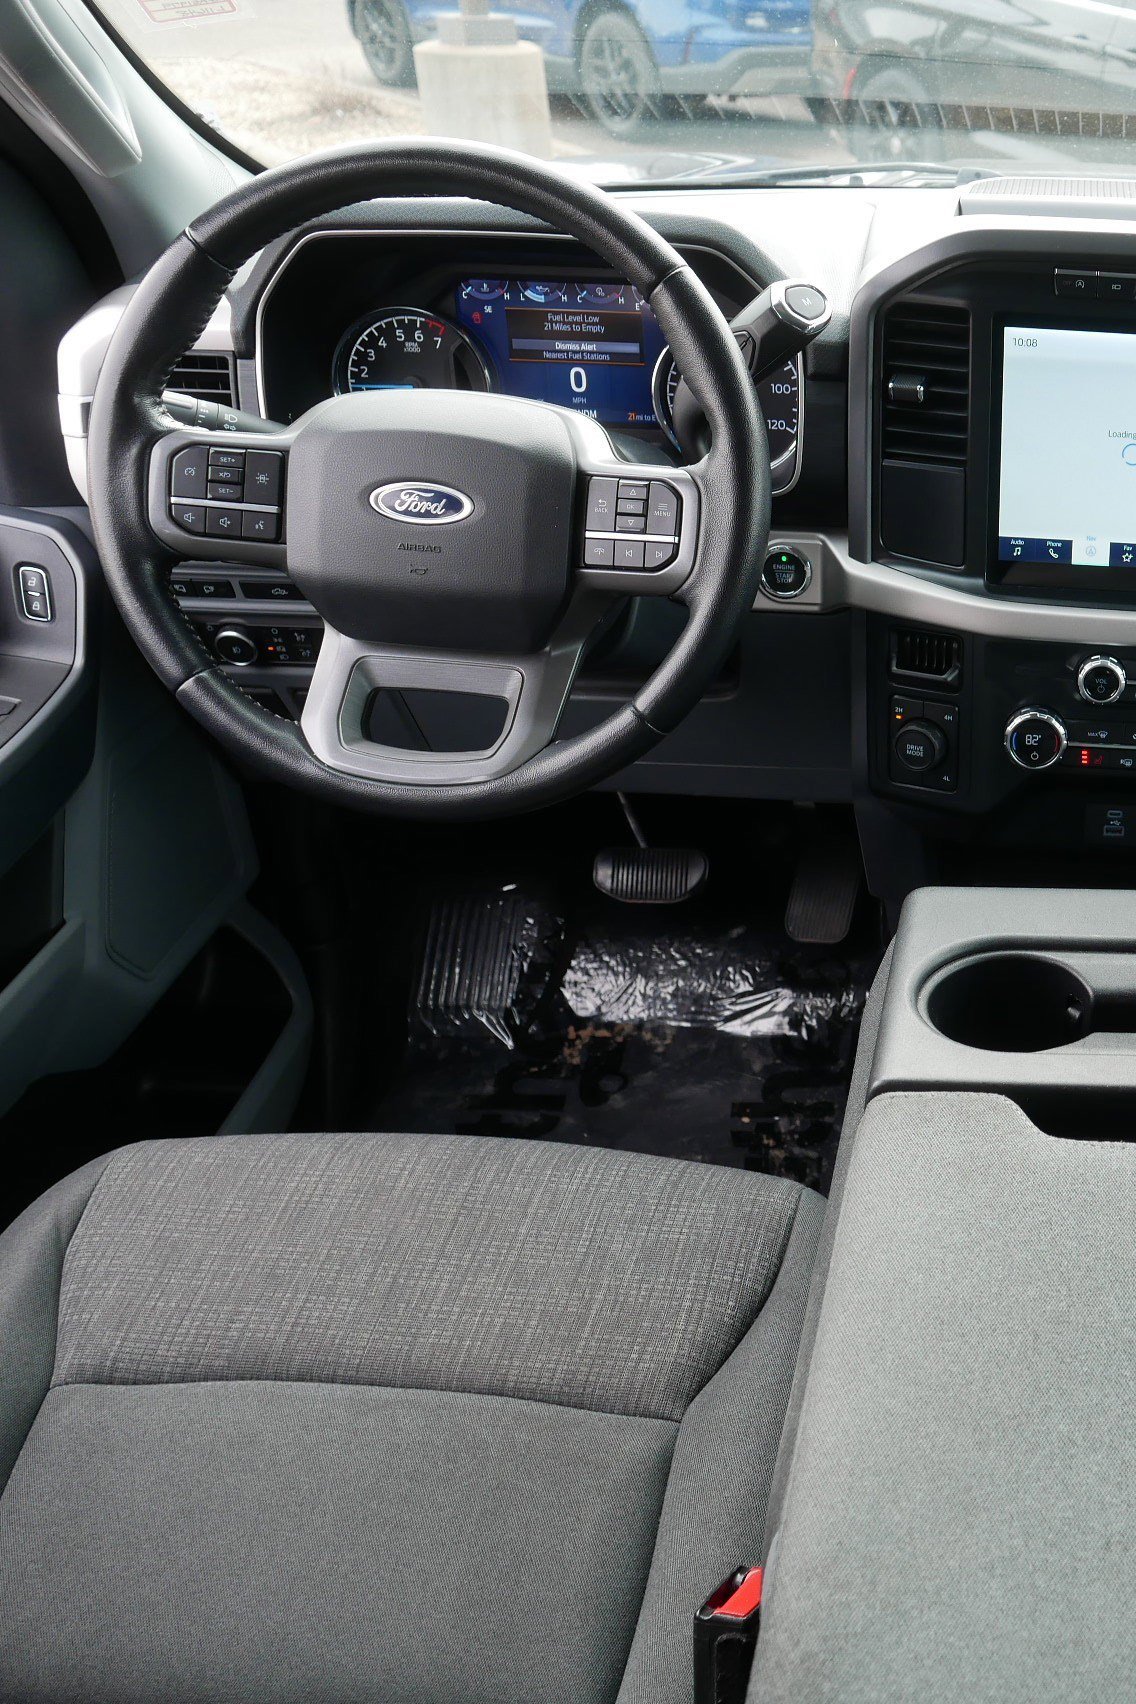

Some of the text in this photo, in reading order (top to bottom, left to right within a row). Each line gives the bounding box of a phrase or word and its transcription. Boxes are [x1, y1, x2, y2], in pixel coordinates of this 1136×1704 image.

[462, 291, 468, 299] C
[504, 292, 510, 300] H
[561, 295, 568, 303] H
[618, 296, 625, 304] H
[635, 302, 640, 311] E
[547, 312, 600, 323] Fuel Level Low
[544, 322, 605, 334] 21 Miles to Empty
[395, 330, 405, 342] 5
[414, 330, 424, 342] 6
[378, 337, 388, 349] 4
[434, 337, 442, 349] 7
[555, 341, 597, 351] Dismiss Alert
[1013, 337, 1038, 347] 10:08
[366, 349, 376, 361] 3
[543, 351, 610, 361] Nearest Fuel Stations
[360, 366, 368, 378] 2
[570, 366, 587, 393] 0
[770, 383, 791, 394] 100
[572, 396, 587, 404] MPH
[627, 412, 636, 421] 21
[767, 419, 786, 430] 120
[394, 489, 447, 515] Ford
[397, 542, 442, 553] AIRBAG
[906, 743, 924, 752] DRIVE
[906, 749, 924, 757] MODE
